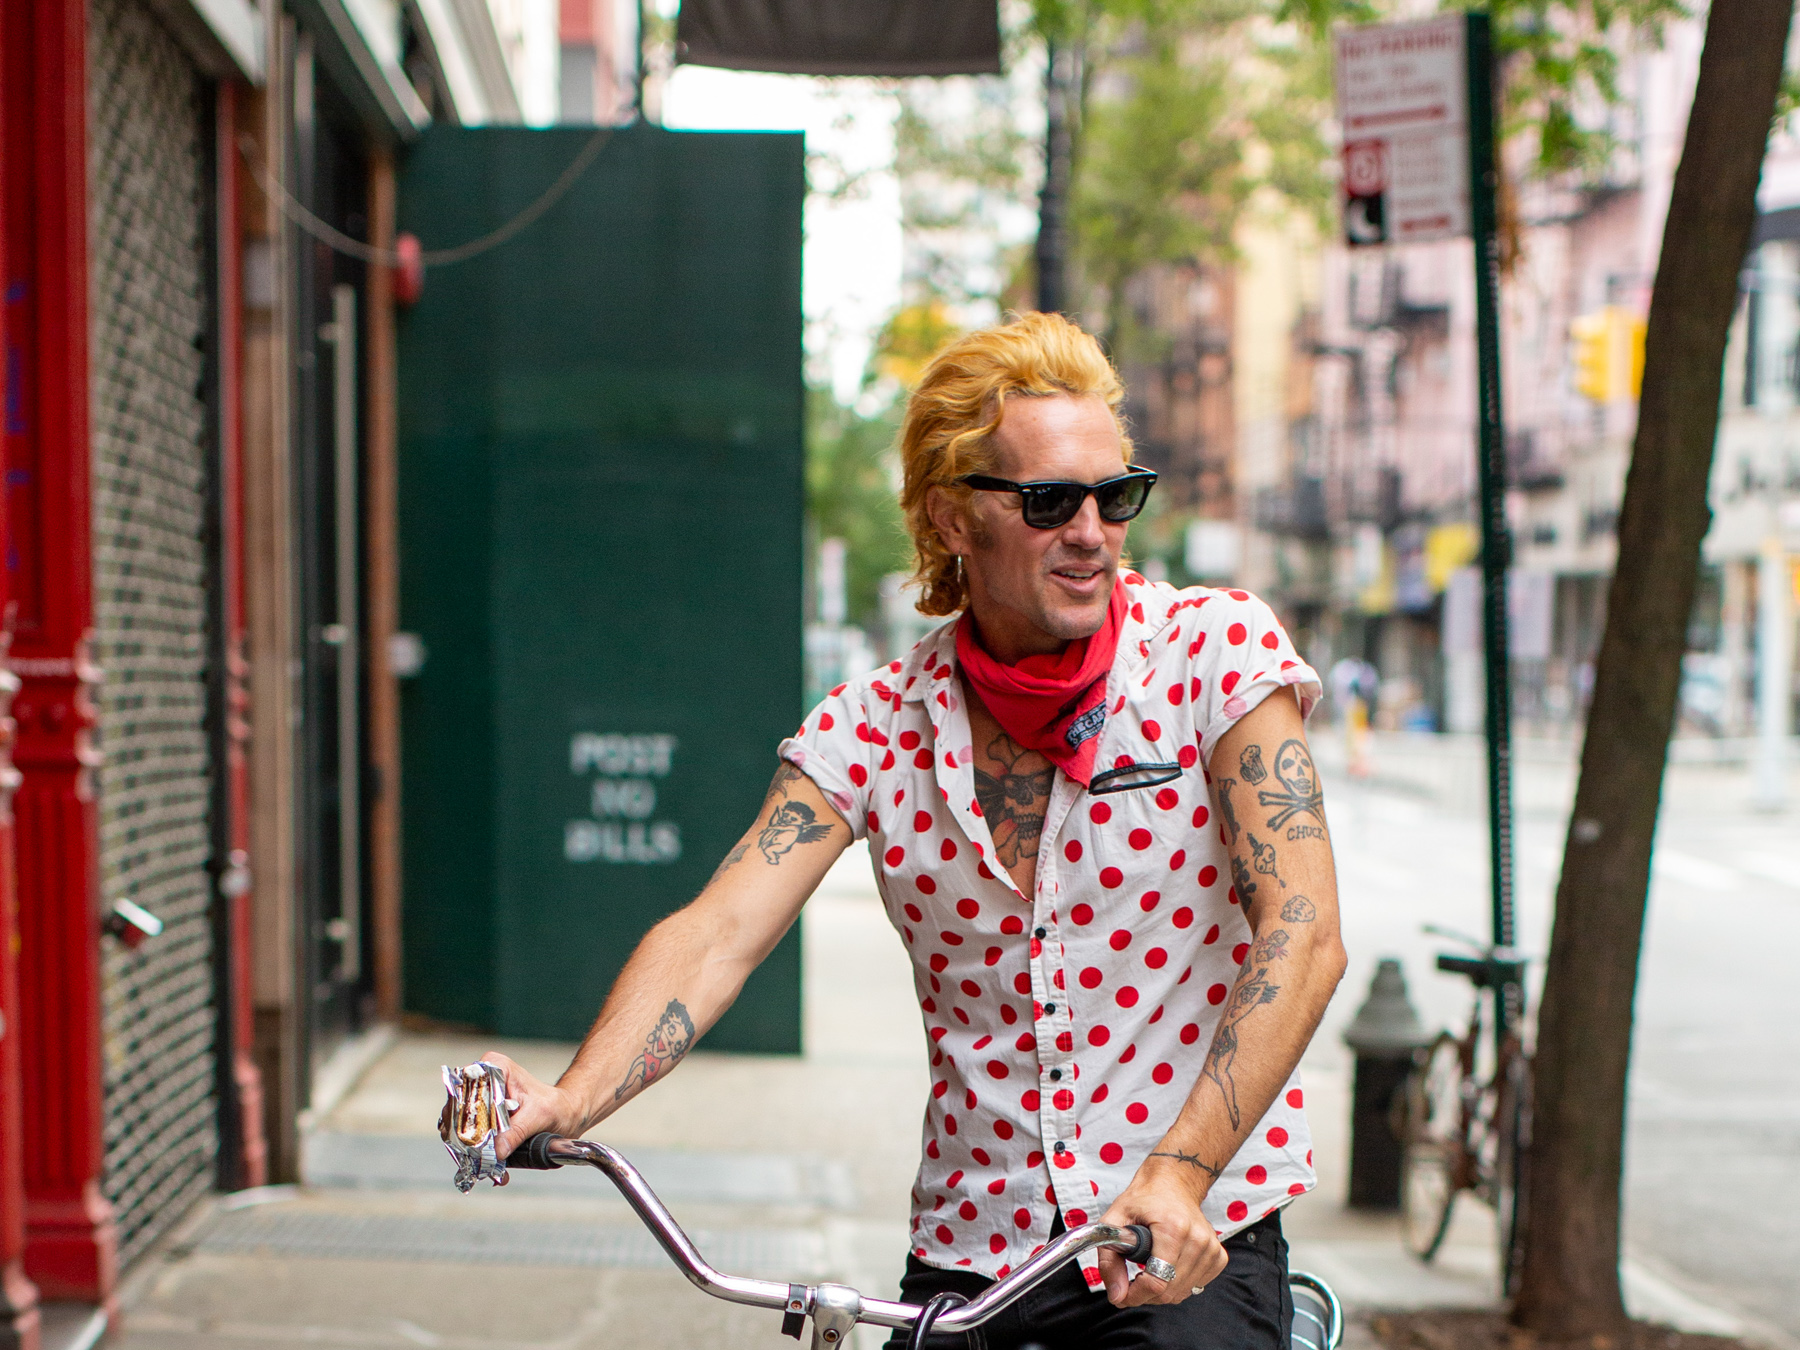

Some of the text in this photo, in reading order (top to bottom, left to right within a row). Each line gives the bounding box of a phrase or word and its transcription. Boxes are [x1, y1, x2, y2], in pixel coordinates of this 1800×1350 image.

[570, 732, 678, 776] POST
[590, 778, 656, 819] NO
[564, 819, 682, 863] BILLS
[1287, 825, 1325, 841] CHUCK
